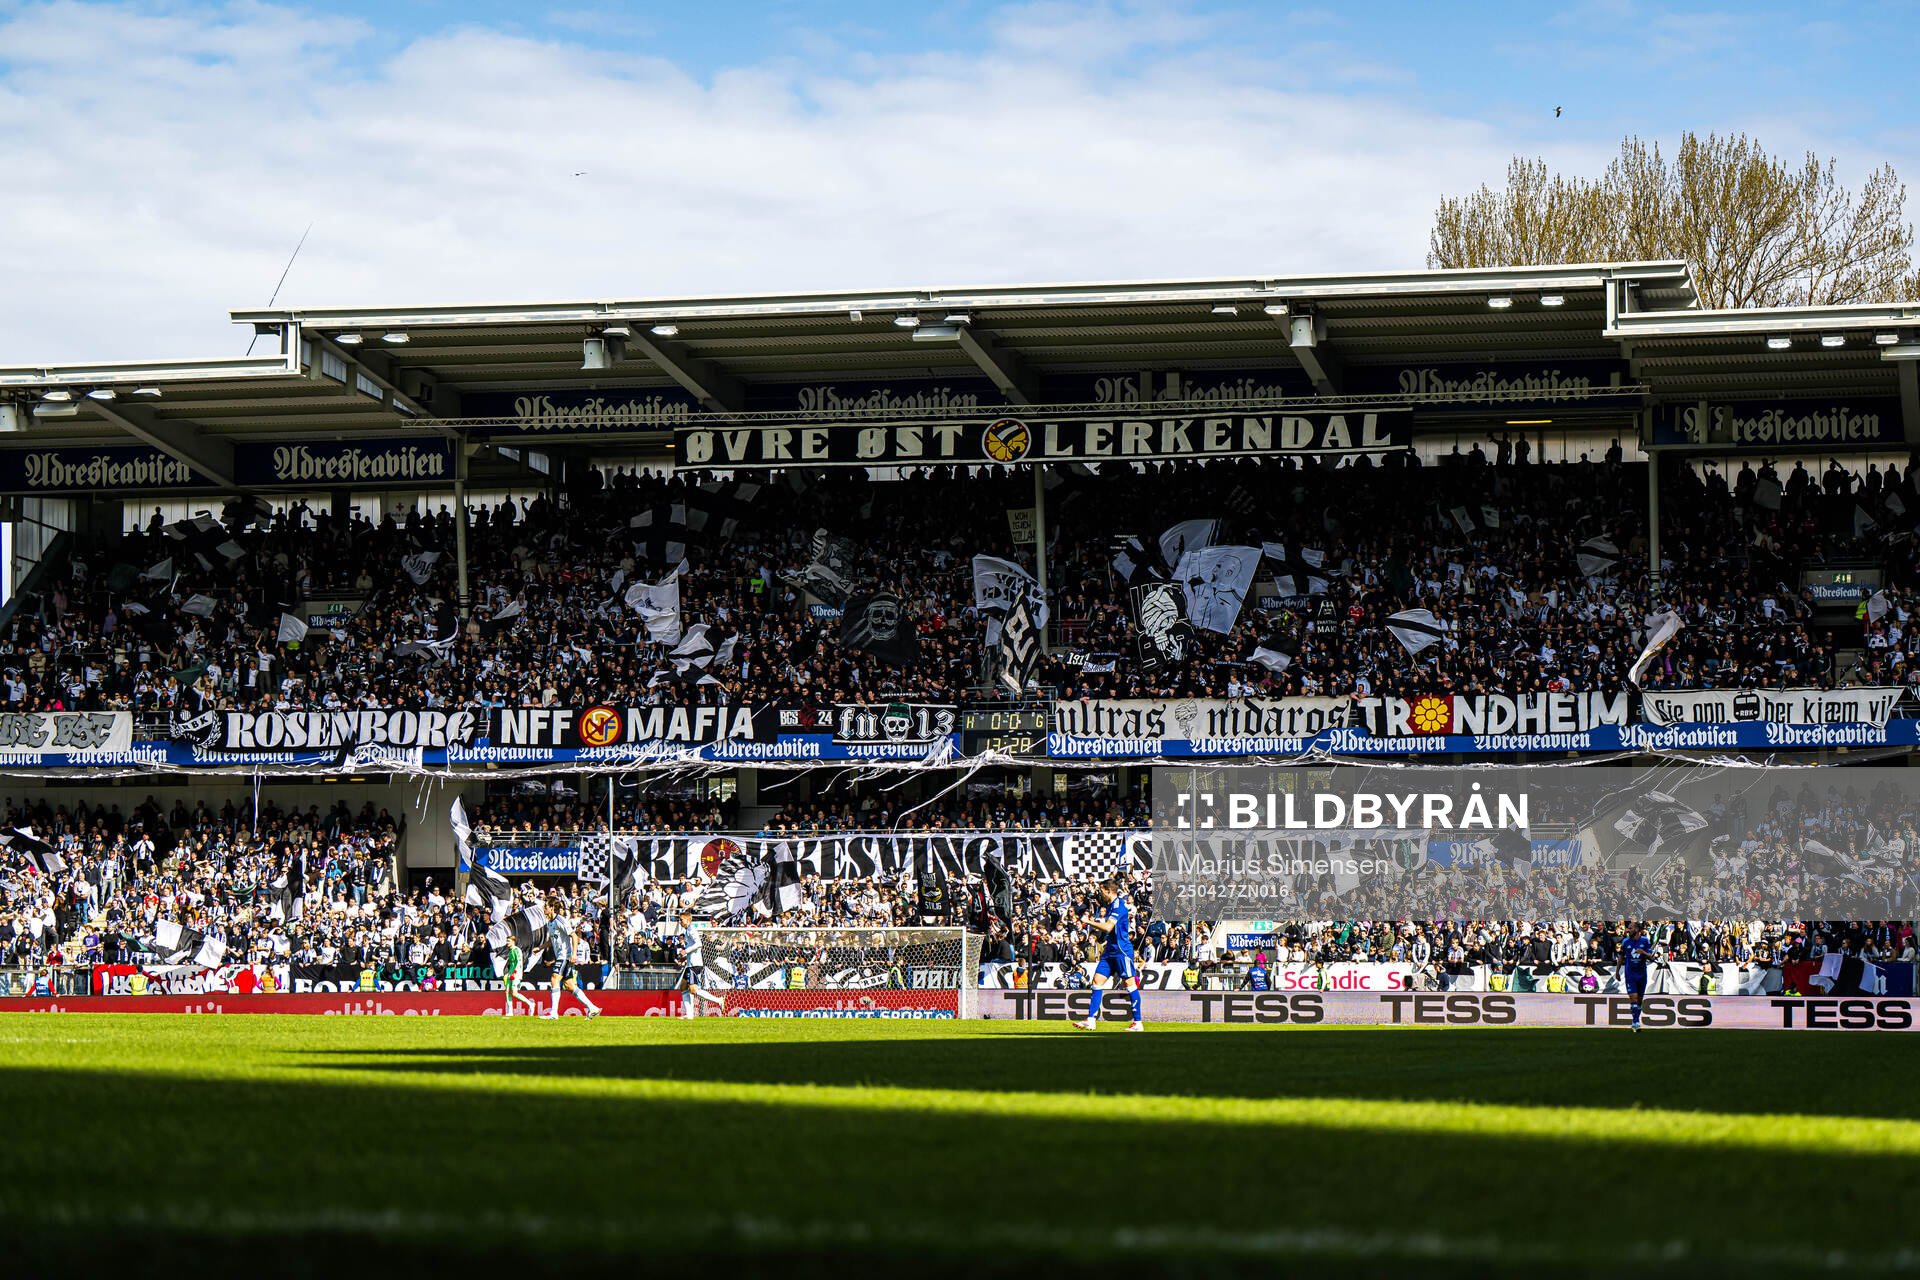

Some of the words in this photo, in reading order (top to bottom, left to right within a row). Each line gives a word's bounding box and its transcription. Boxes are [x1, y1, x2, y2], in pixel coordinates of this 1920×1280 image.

[686, 428, 829, 463] ØVRE
[856, 425, 963, 459] ØST
[1044, 414, 1391, 456] LERKENDAL
[226, 710, 476, 748] ROSENBORG
[501, 709, 573, 745] NFF
[627, 706, 754, 742] MAFIA
[818, 710, 833, 725] 24
[1004, 993, 1134, 1021] TESS
[1190, 993, 1324, 1023] TESS
[1380, 995, 1516, 1024] TESS
[1574, 996, 1713, 1027] TESS
[1771, 999, 1912, 1029] TESS
